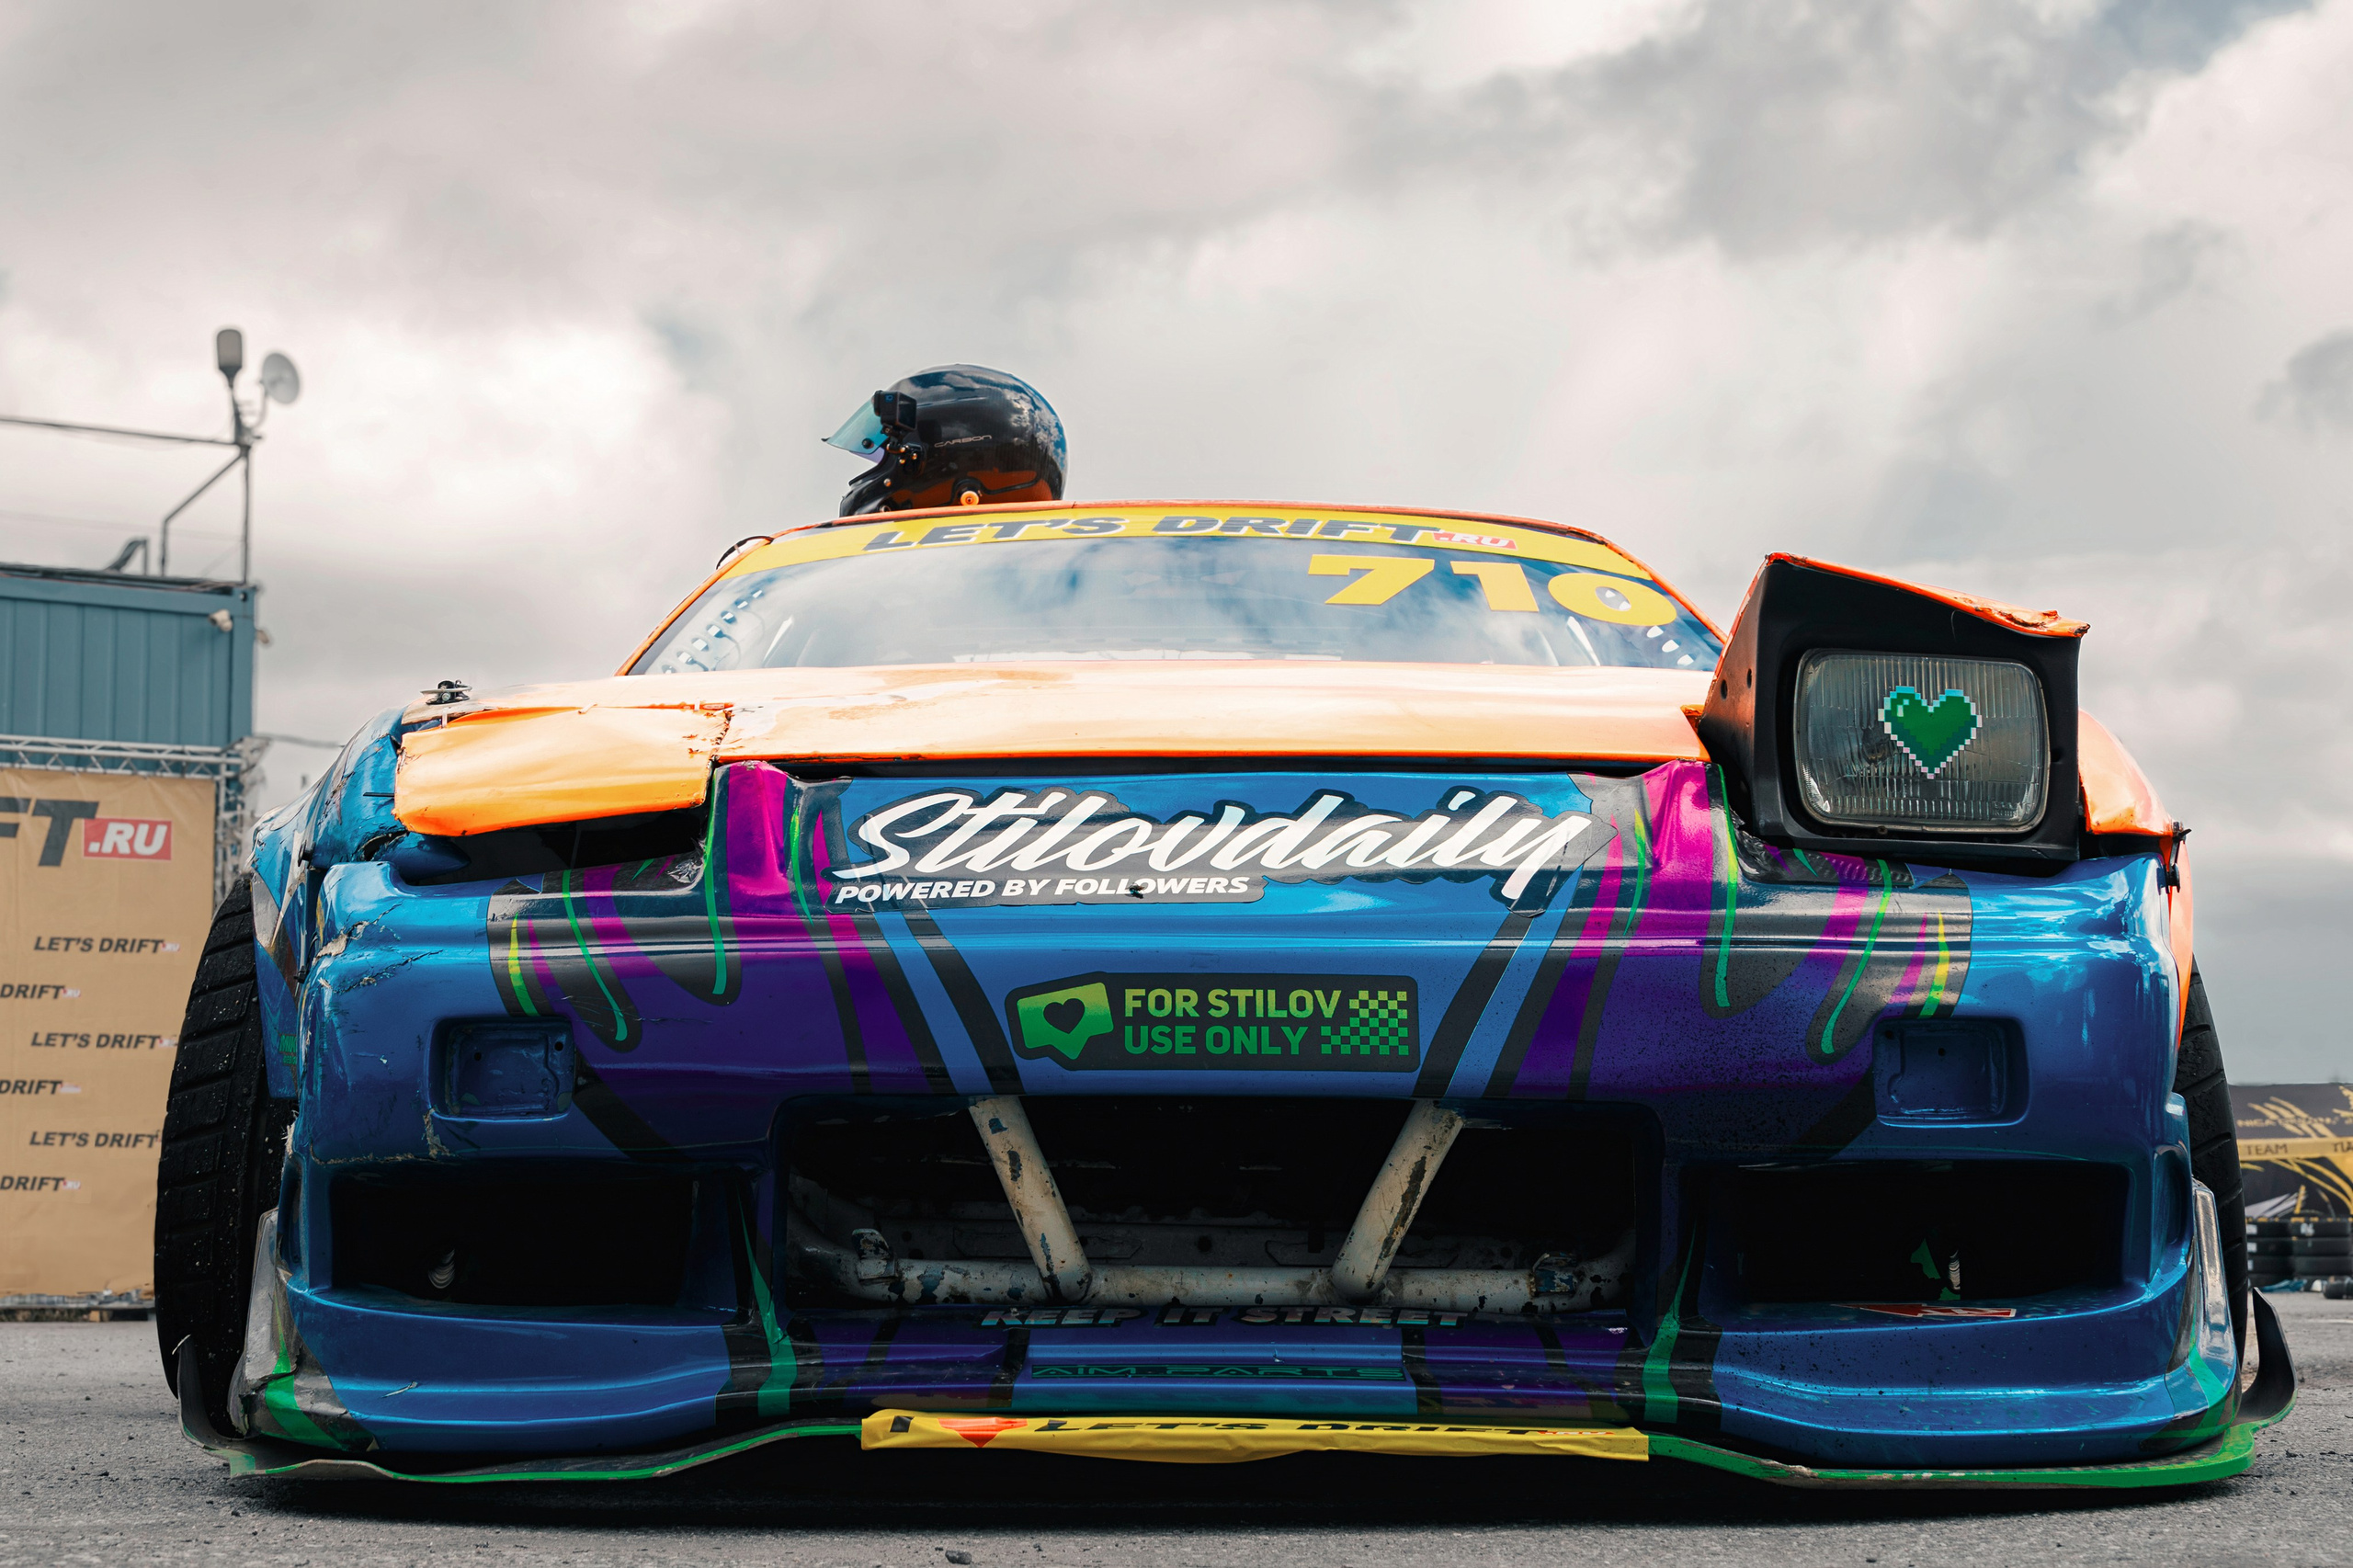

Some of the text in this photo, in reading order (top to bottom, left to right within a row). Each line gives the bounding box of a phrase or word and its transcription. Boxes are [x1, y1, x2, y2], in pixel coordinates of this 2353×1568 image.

[934, 434, 992, 448] CARBON
[862, 517, 1130, 551] LET'S
[1152, 516, 1446, 544] DRIFT
[1309, 554, 1677, 627] 710
[832, 790, 1592, 899] Stilovdaily
[835, 876, 1250, 904] POWERED BY FOLLOWERS
[34, 937, 94, 952] LET'S
[98, 937, 164, 953] DRIFT
[1125, 988, 1341, 1018] FOR STILOV
[31, 1032, 91, 1048] LET'S
[96, 1033, 161, 1049] DRIFT
[1124, 1025, 1309, 1055] USE ONLY
[29, 1131, 159, 1148] LET'S DRIFT
[2246, 1143, 2289, 1155] TEAM
[981, 1306, 1468, 1325] KEEP IT STREET
[1032, 1366, 1404, 1378] AIM PARTS
[1034, 1419, 1269, 1432] LET'S
